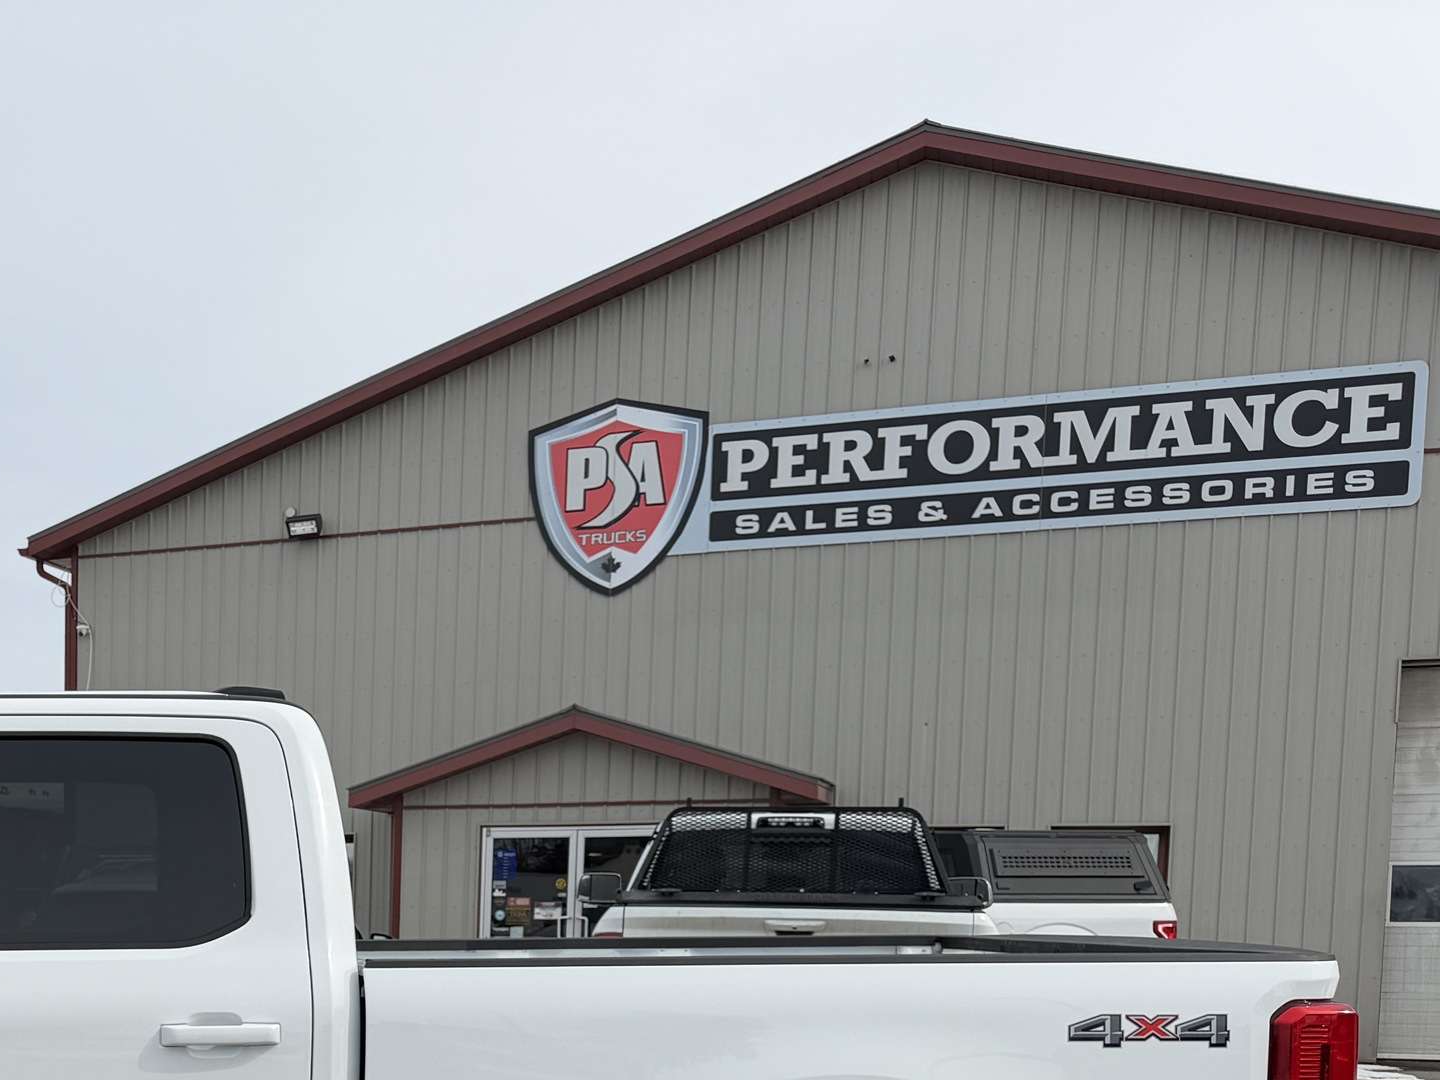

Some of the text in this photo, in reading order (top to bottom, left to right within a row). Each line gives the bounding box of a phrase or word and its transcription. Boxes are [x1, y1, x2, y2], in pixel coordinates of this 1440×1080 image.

[720, 382, 1403, 492] PERFORMANCE
[564, 430, 666, 530] PSA
[735, 469, 1375, 535] SALES & ACCESSORIES
[578, 529, 648, 546] TRUCKS
